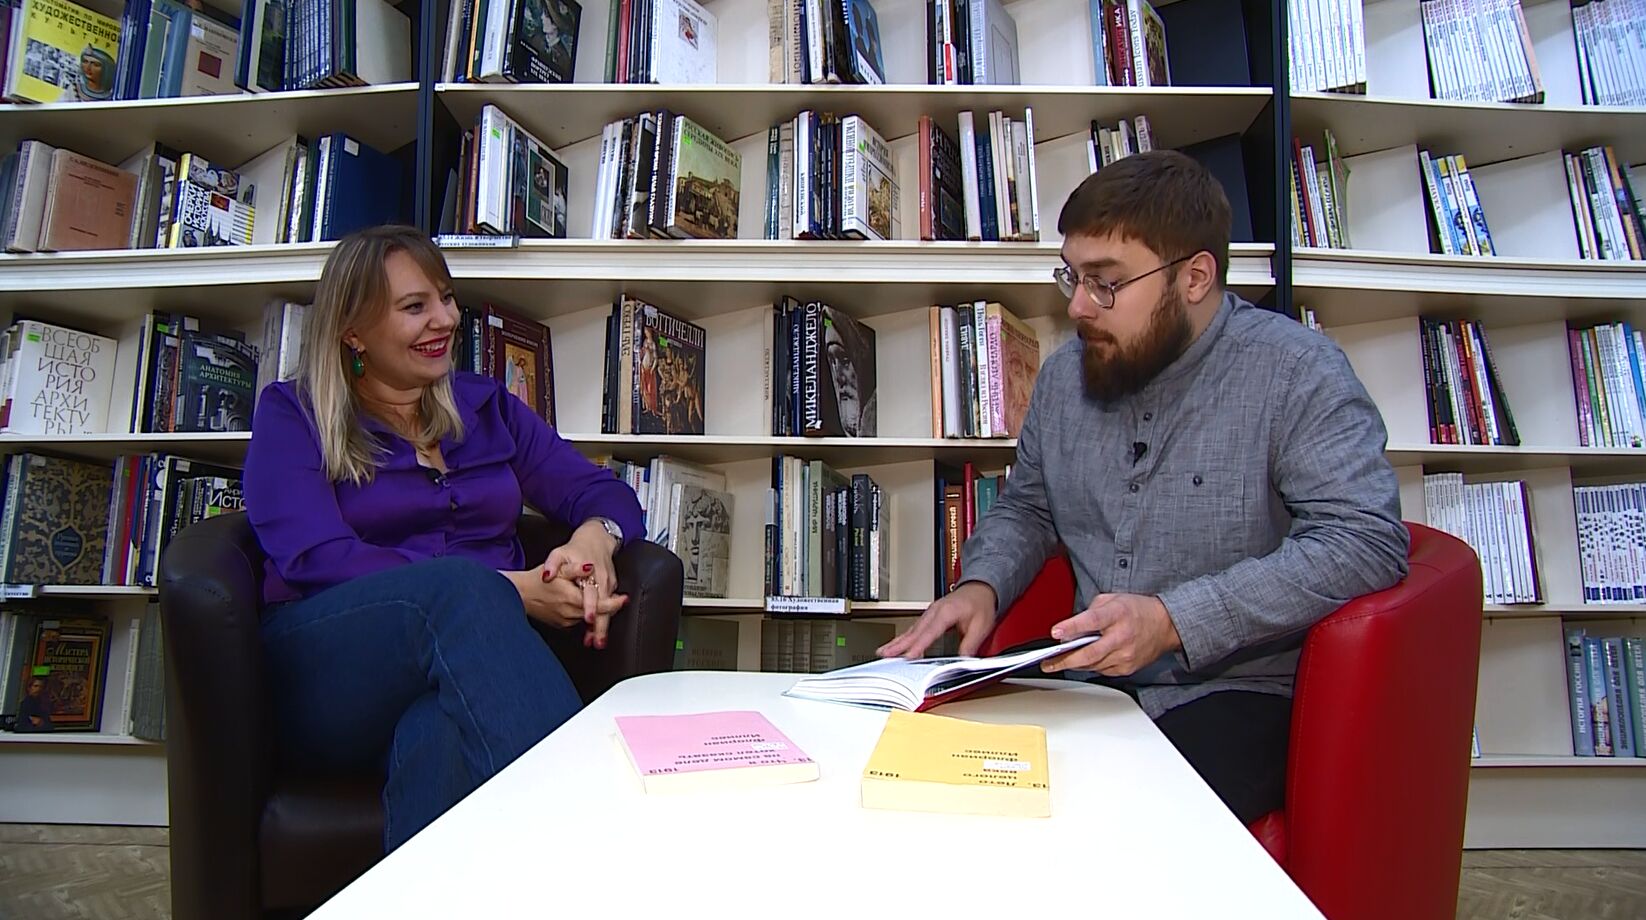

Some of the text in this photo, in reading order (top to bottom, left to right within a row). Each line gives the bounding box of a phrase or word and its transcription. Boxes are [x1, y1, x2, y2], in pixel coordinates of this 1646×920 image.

[31, 12, 112, 49] КУЛЬТУР
[1130, 9, 1144, 87] ussian Icons Today
[184, 183, 198, 226] ОЧЕРКИ
[41, 326, 100, 353] ВСЕОБ
[621, 303, 632, 357] ЭЛЬ ГРЕКО
[645, 311, 705, 349] БОТТИЧЕЛЛИ
[38, 357, 96, 383] ИСТО
[200, 364, 241, 379] АНАТОМИЯ
[805, 302, 817, 430] МИКЕЛАНДЖЕЛО
[45, 374, 84, 395] РИЯ
[199, 371, 251, 389] АРХИТЕКТУРЫ
[34, 390, 89, 412] АРХИ
[30, 402, 91, 427] ТЕКТУ
[770, 604, 808, 613] фотография
[1573, 662, 1586, 734] ИСТОРИЯ РОССИИ
[648, 766, 679, 775] 1913
[869, 769, 900, 779] 1913
